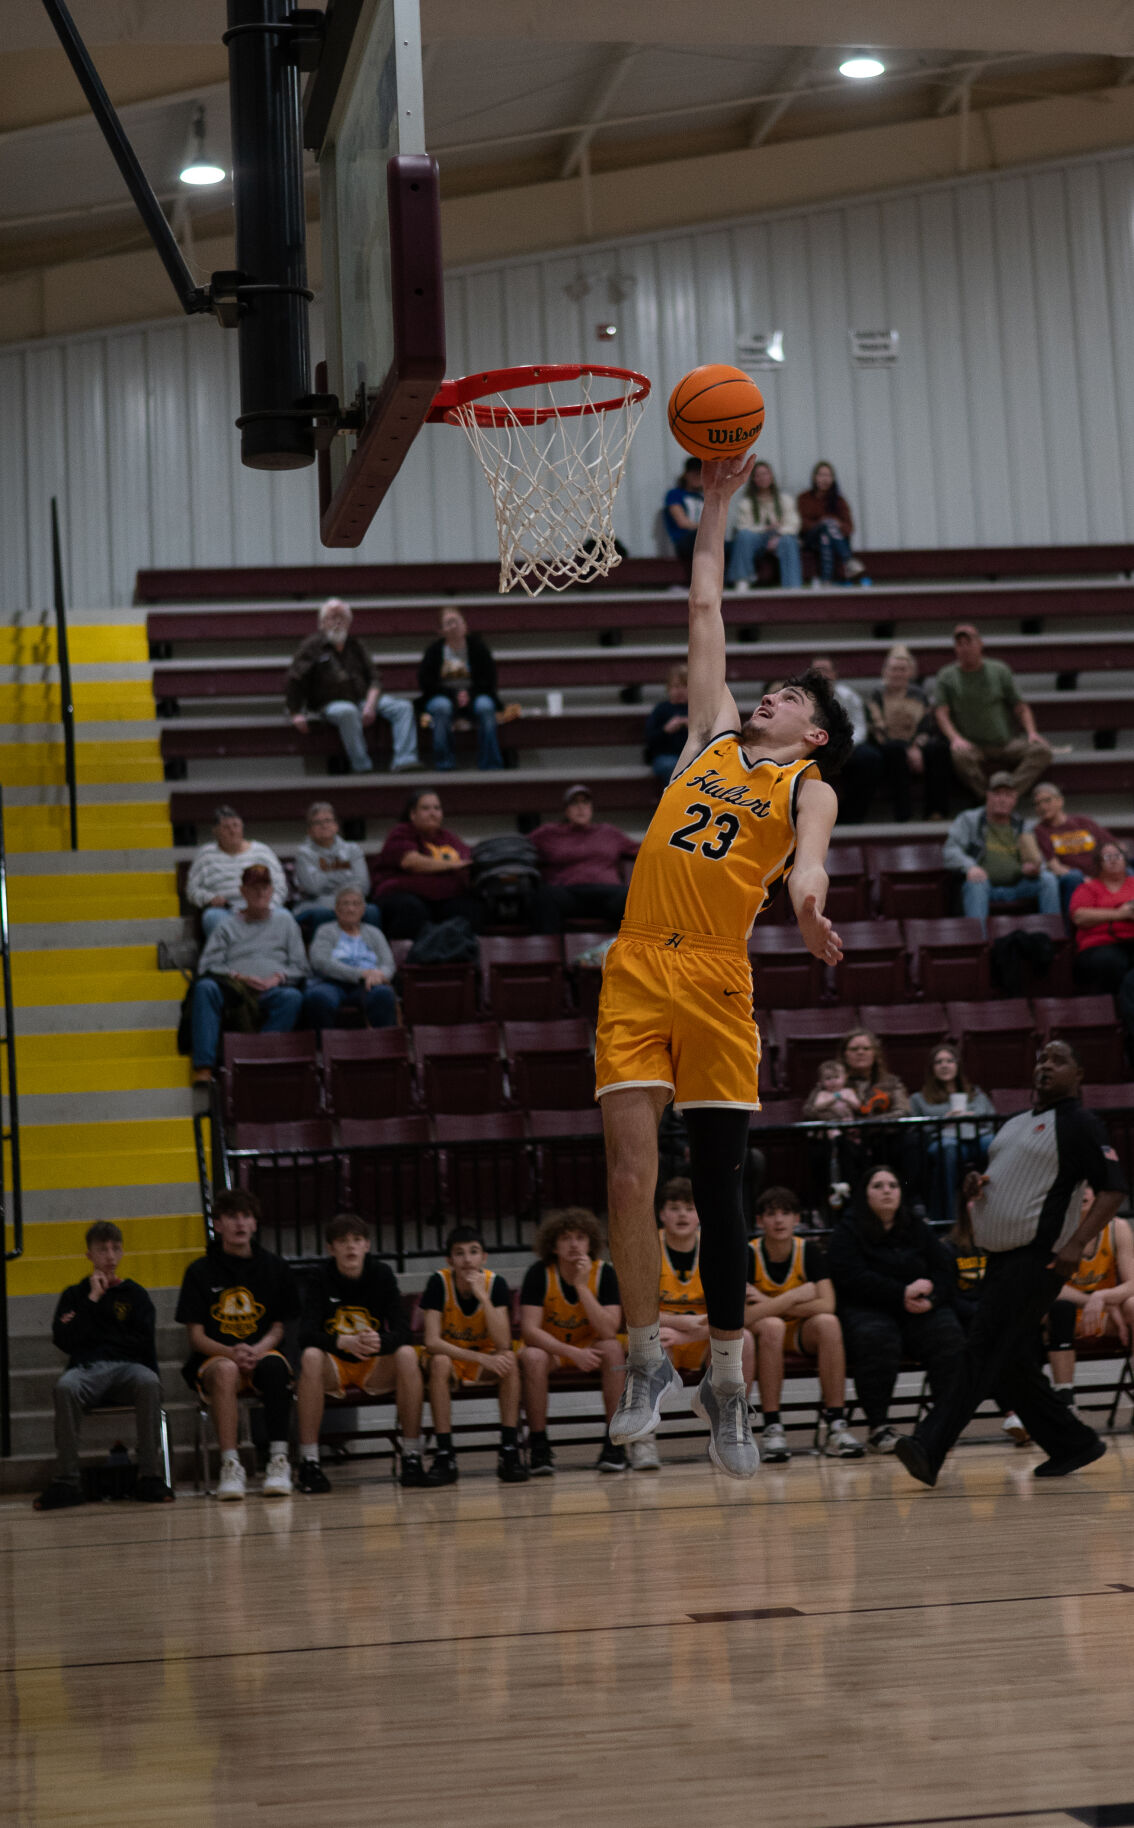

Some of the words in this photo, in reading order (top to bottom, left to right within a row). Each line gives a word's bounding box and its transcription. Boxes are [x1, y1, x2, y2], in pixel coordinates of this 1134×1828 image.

[707, 422, 762, 444] Wilson
[686, 769, 771, 818] Hulbert
[668, 802, 740, 861] 23
